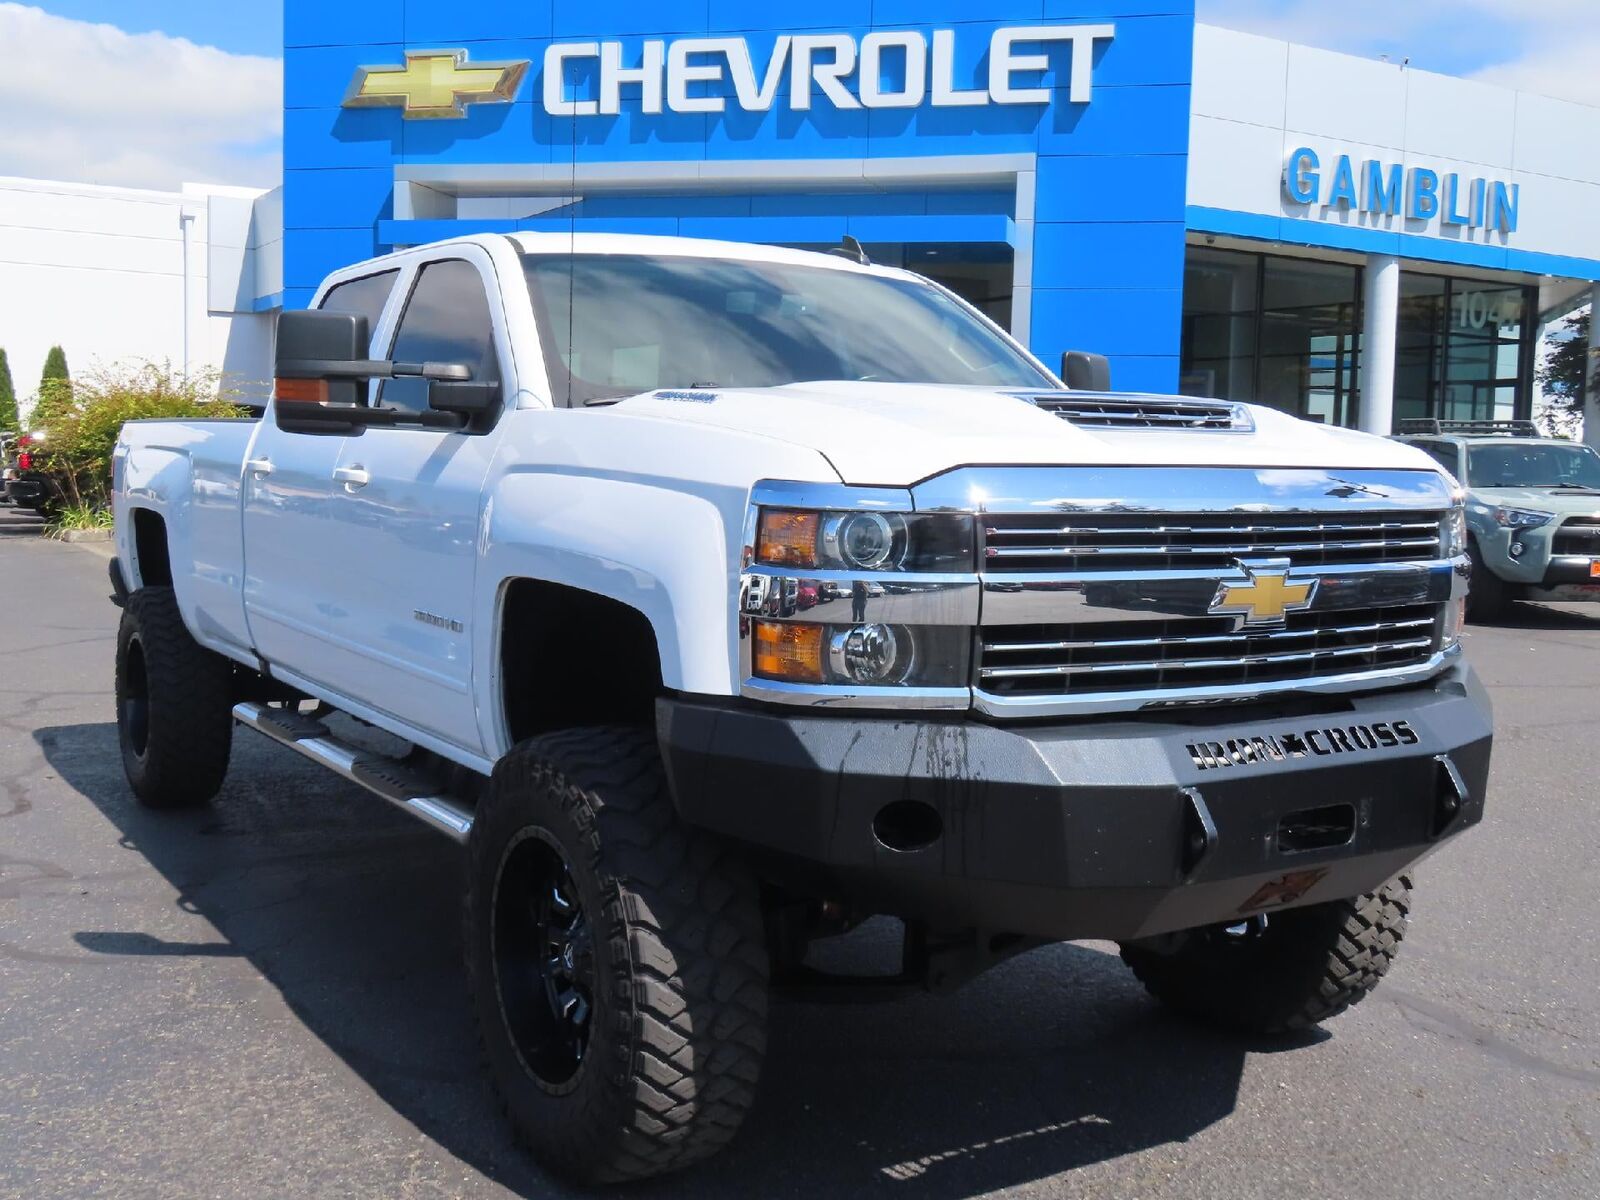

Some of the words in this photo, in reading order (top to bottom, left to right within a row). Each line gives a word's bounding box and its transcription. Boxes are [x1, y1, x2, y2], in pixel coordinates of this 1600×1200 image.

[543, 24, 1115, 116] CHEVROLET
[1283, 147, 1519, 233] GAMBLIN
[1186, 735, 1287, 771] IRON
[1304, 720, 1420, 756] CROSS
